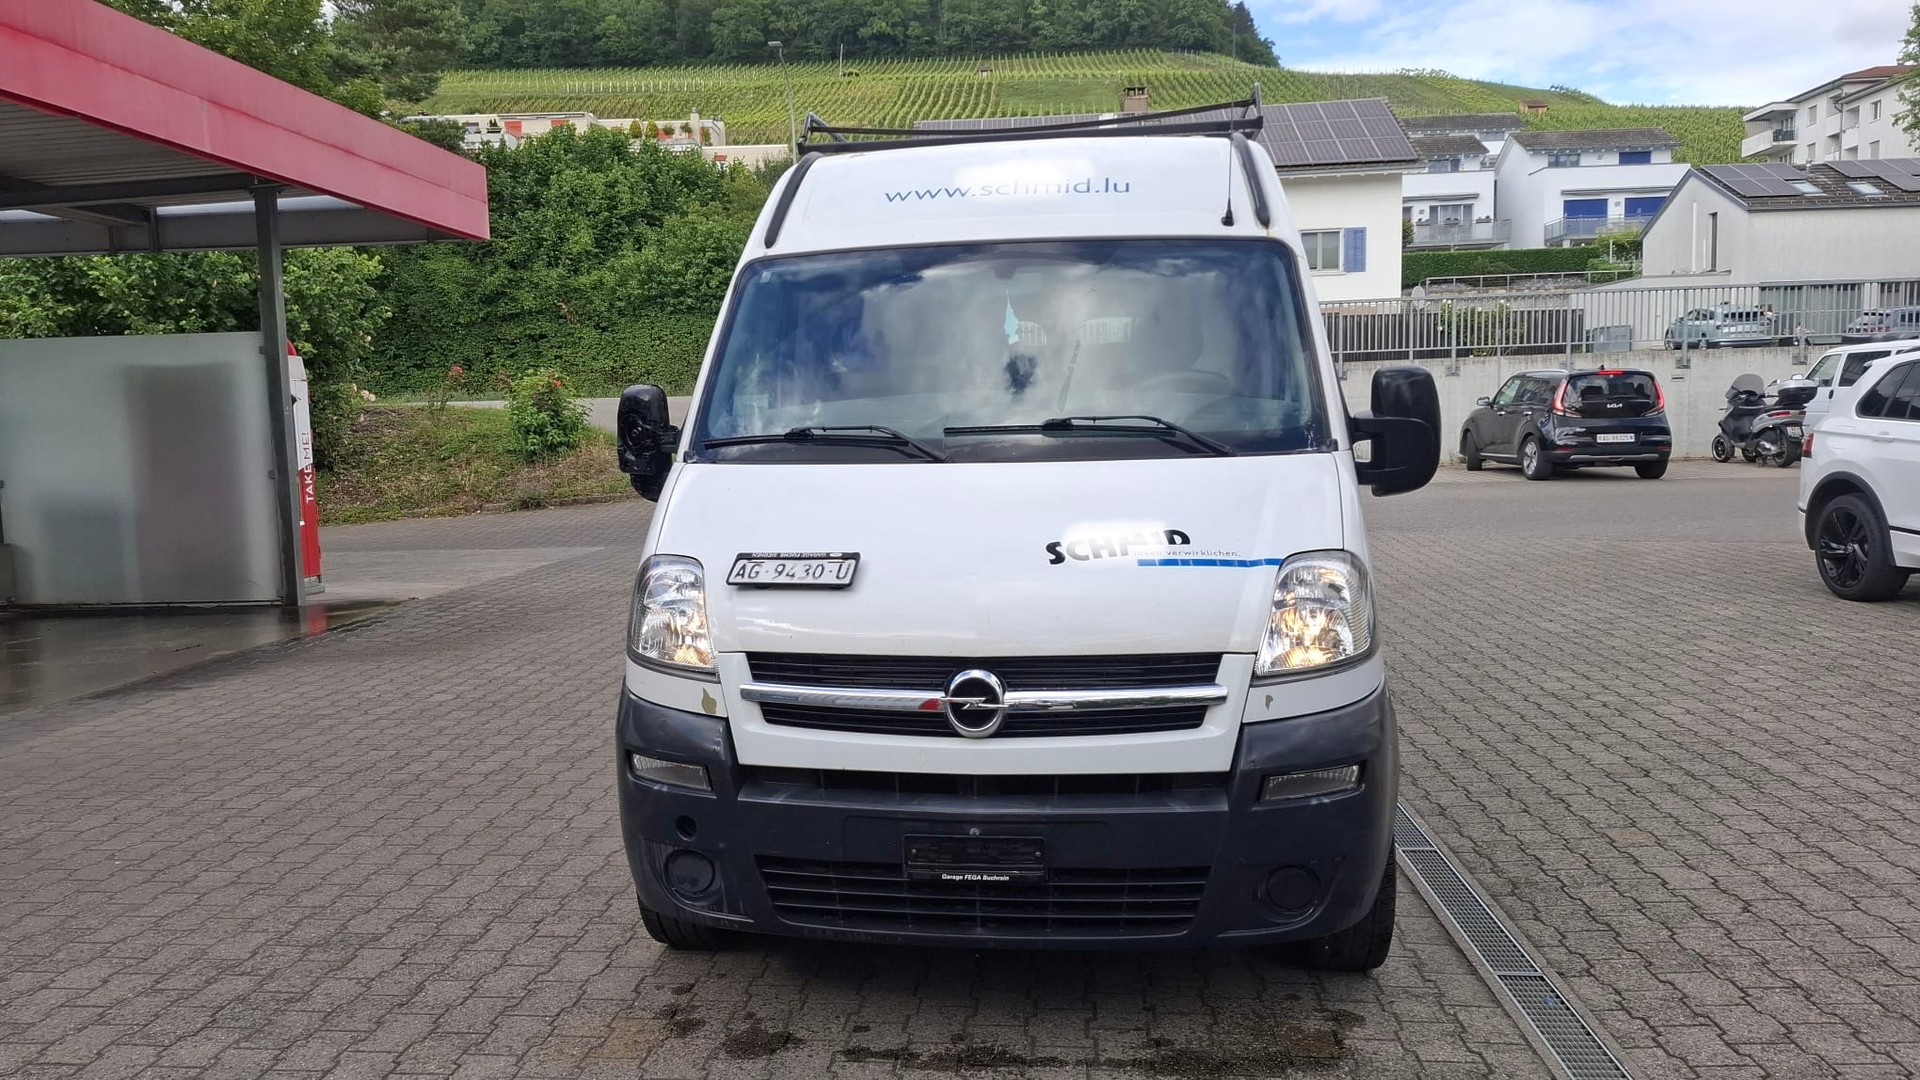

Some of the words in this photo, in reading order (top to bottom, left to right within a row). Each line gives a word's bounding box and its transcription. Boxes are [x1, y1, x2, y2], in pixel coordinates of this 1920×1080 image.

[885, 178, 1131, 202] www.schmid.lu
[301, 432, 310, 460] ME!
[303, 464, 314, 504] TAKE
[1045, 529, 1191, 565] SCHMID
[941, 873, 963, 881] Garage
